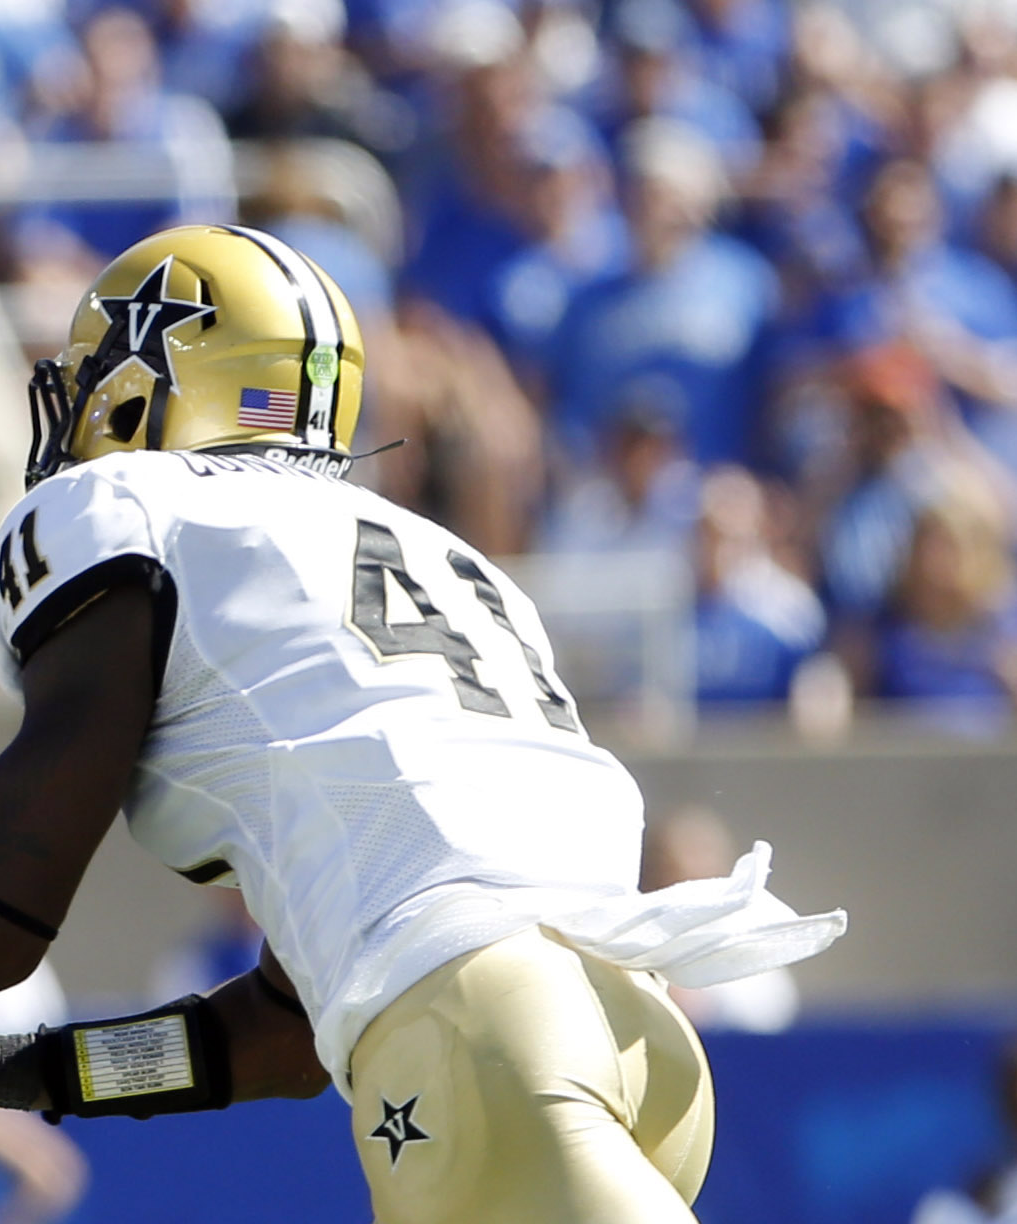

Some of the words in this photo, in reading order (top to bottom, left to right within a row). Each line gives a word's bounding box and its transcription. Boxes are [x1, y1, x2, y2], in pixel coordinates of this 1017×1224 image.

[127, 302, 162, 353] V
[309, 409, 326, 431] 41
[343, 517, 580, 734] 41
[384, 1110, 407, 1141] V
